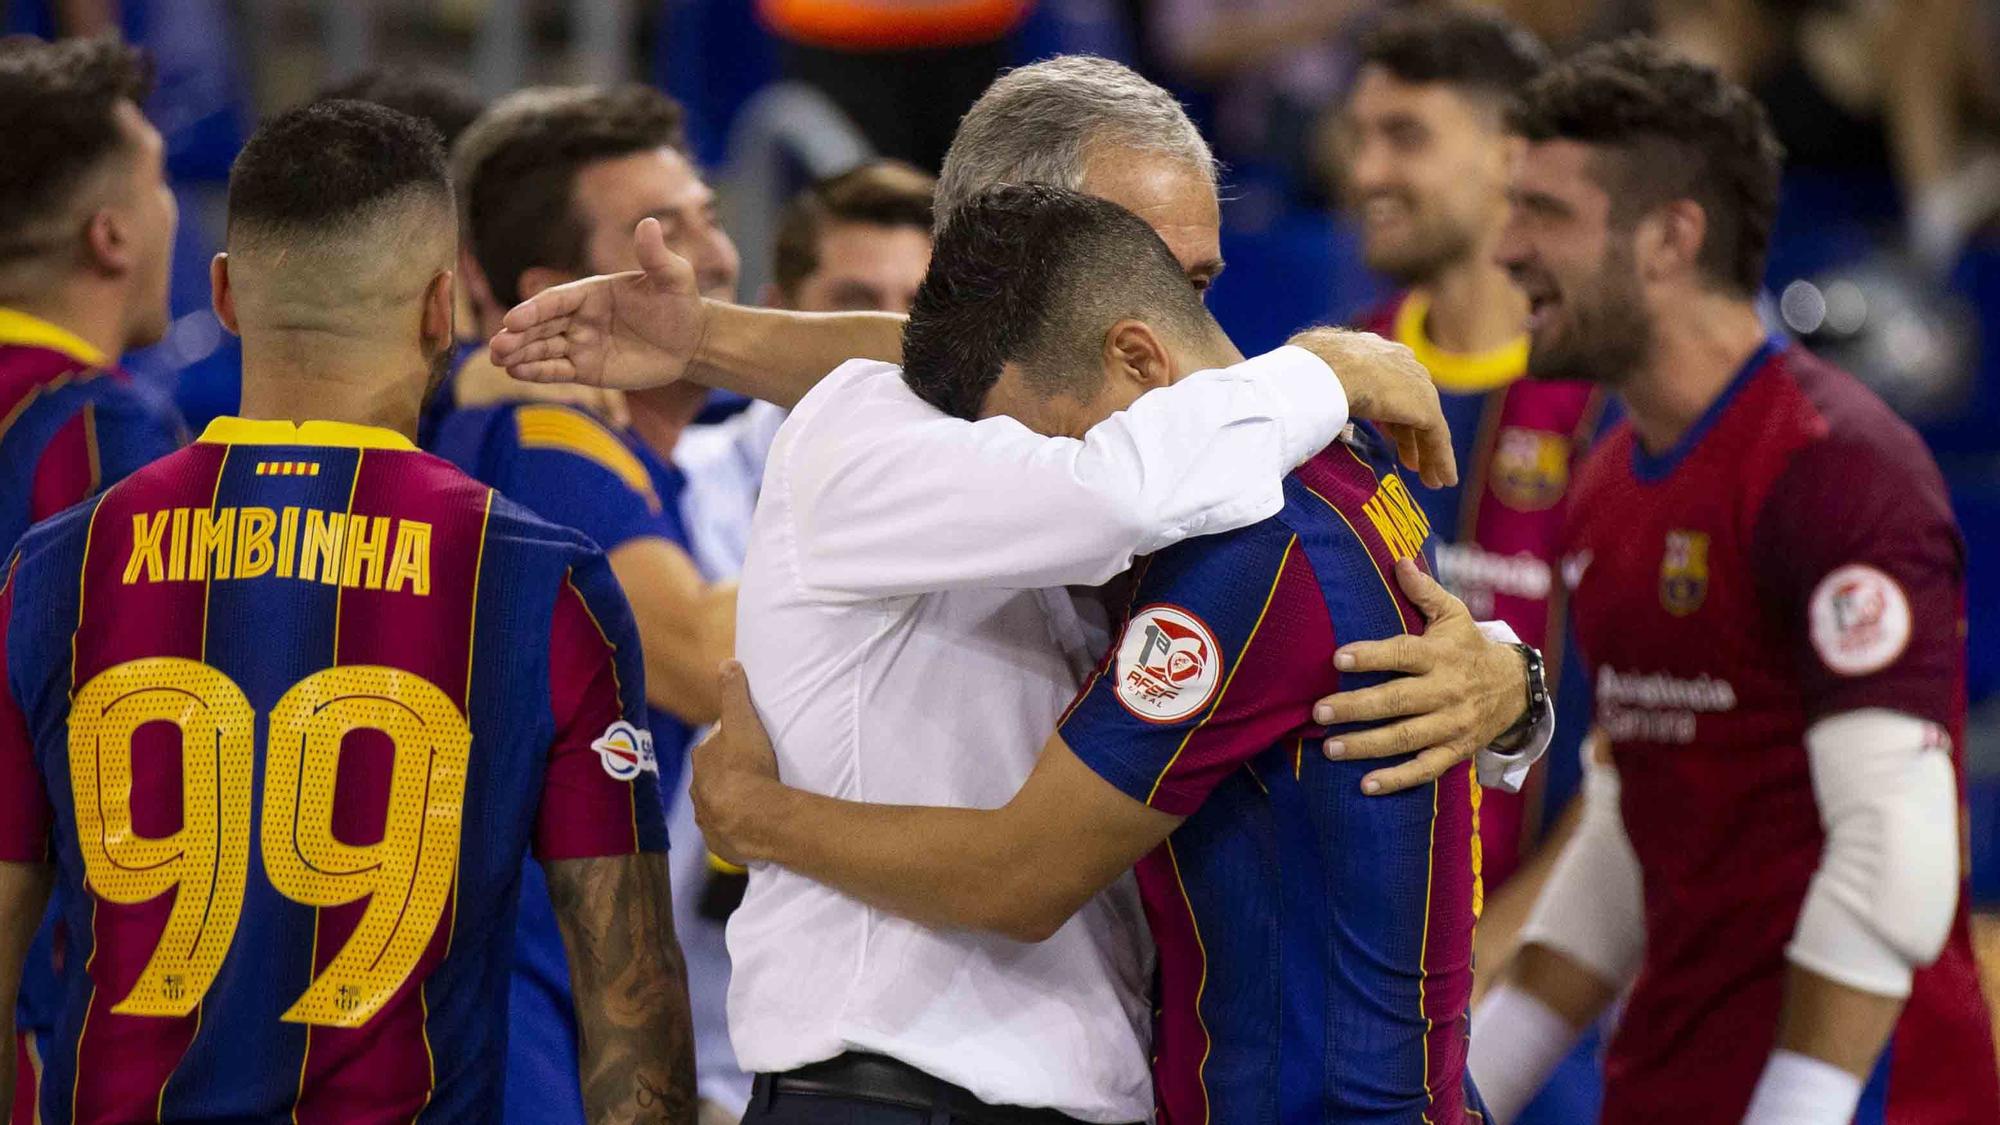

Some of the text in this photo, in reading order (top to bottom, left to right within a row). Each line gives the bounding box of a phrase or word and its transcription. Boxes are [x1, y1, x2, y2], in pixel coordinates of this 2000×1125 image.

[122, 506, 432, 596] XIMBINHA
[1362, 473, 1430, 563] MAR
[1127, 670, 1179, 700] RFEF
[67, 656, 472, 1029] 99
